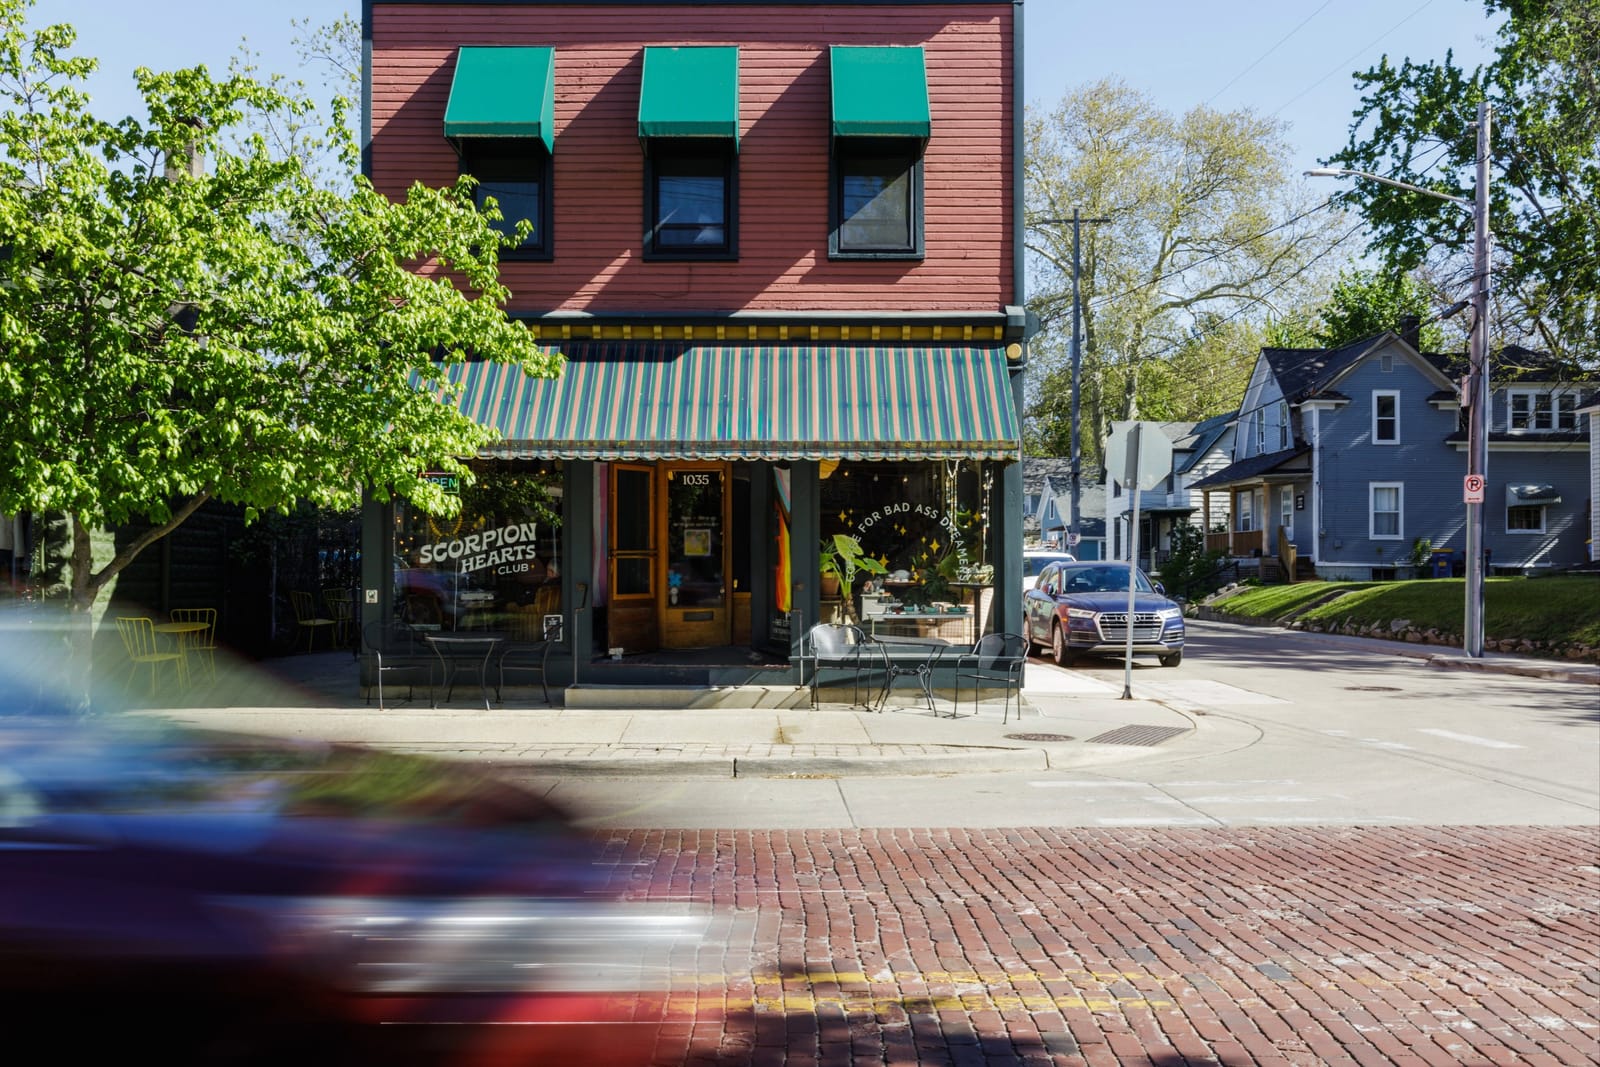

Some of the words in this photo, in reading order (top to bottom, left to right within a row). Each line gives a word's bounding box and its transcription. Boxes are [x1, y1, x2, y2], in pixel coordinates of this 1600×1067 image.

[683, 474, 710, 486] 1035
[419, 522, 537, 564] SCORPION
[845, 534, 862, 582] COEE
[858, 511, 882, 533] FOR
[883, 502, 910, 516] BAD
[914, 503, 939, 519] ASS
[461, 544, 536, 574] HEARTS
[497, 563, 529, 575] CLUB
